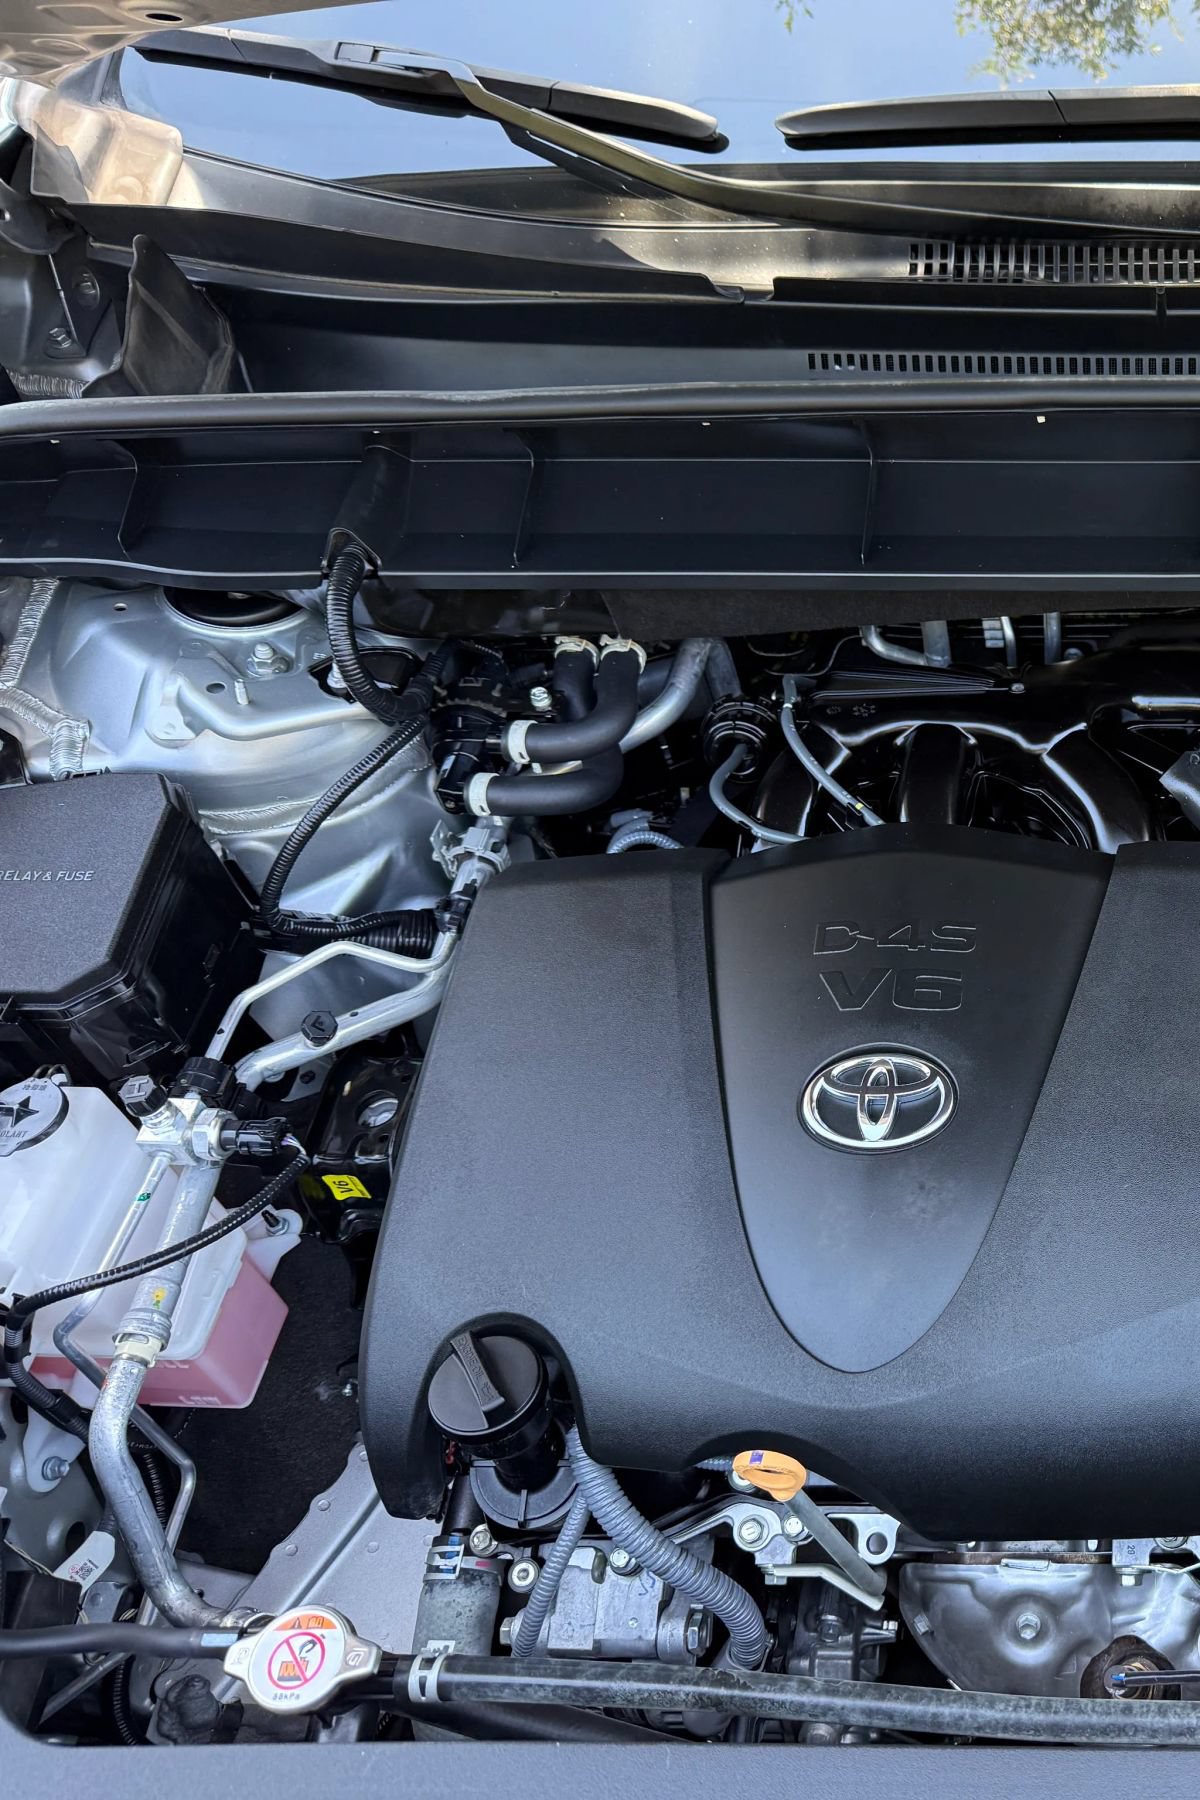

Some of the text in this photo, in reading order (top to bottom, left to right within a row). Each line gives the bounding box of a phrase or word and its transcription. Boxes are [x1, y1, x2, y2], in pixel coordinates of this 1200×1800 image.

[42, 871, 52, 881] &
[56, 870, 94, 881] FUSE
[813, 920, 977, 955] D-4S
[818, 967, 963, 1012] V6
[333, 1180, 354, 1194] V6
